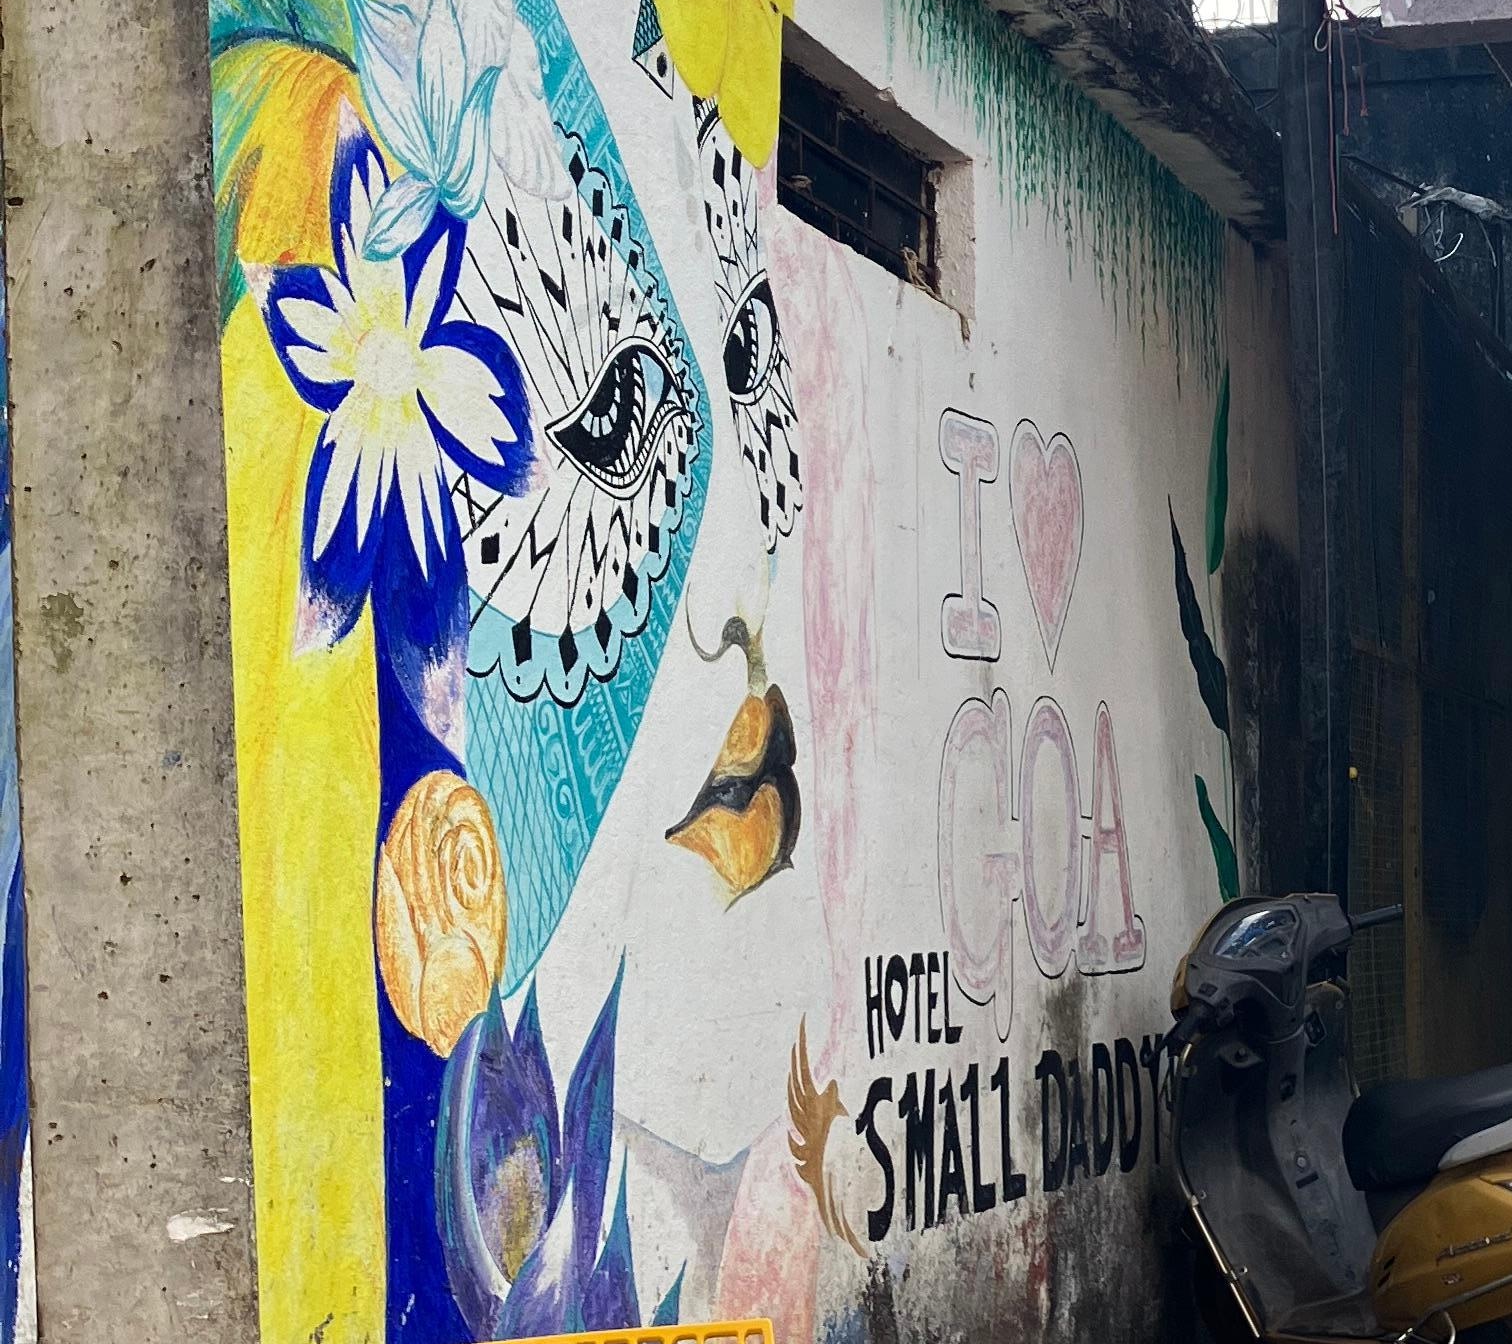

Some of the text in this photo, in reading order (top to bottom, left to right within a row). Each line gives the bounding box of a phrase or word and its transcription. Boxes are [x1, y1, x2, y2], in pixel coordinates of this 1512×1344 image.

[938, 687, 1147, 1043] GOA
[864, 951, 964, 1059] HOTEL
[855, 1033, 1165, 1242] SMALL DADDY
